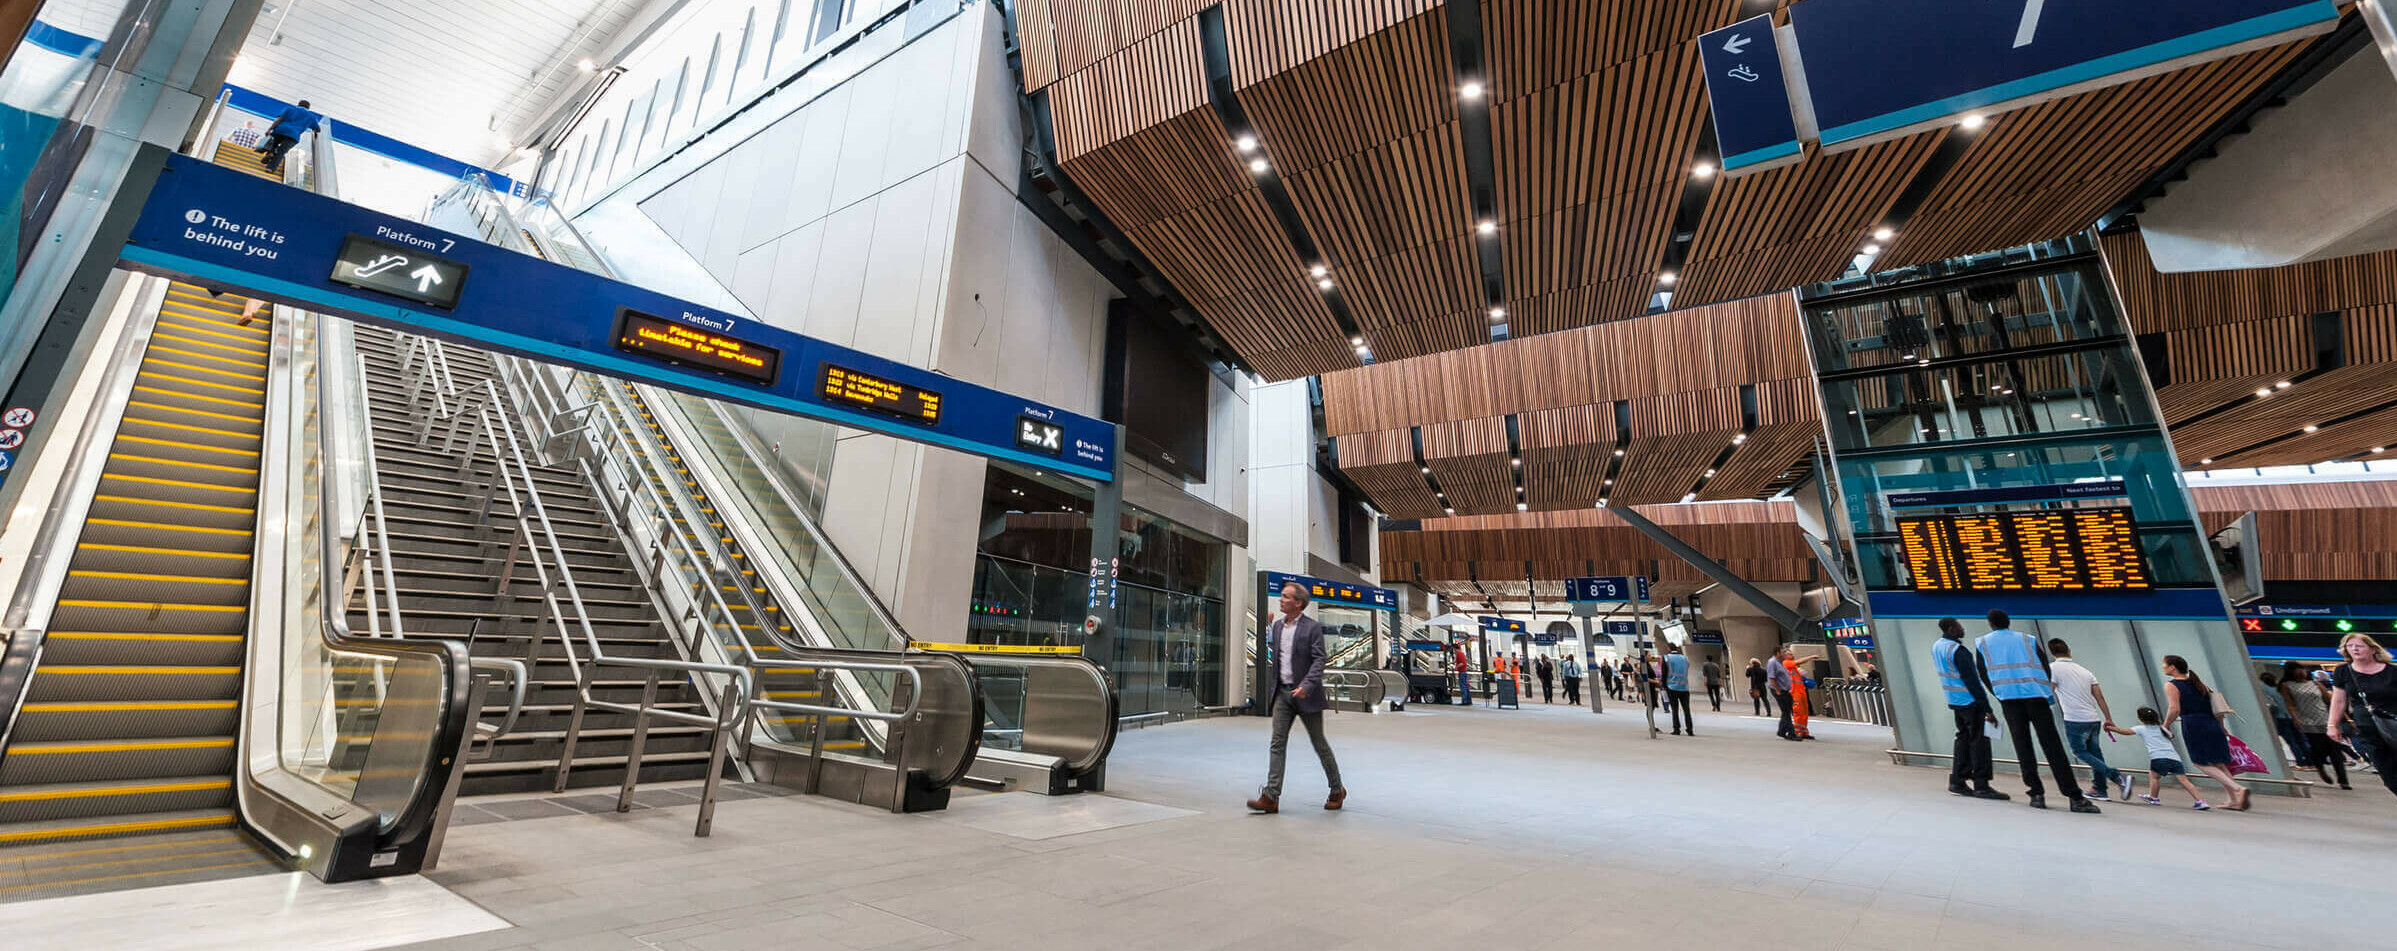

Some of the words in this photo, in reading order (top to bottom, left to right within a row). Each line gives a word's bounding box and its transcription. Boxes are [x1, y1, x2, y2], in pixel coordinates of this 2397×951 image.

[211, 215, 241, 233] The
[243, 224, 269, 240] lift
[271, 231, 286, 244] is
[183, 227, 246, 251] behind
[245, 245, 278, 260] you
[376, 226, 436, 250] Platform
[440, 238, 456, 254] 7
[682, 311, 723, 330] Platform
[725, 319, 736, 332] 7
[669, 325, 708, 343] Please
[709, 337, 742, 351] check
[638, 326, 693, 349] timetable
[695, 342, 715, 354] for
[717, 350, 764, 367] services
[1024, 406, 1048, 419] Platform
[1048, 409, 1054, 420] 7
[1022, 430, 1042, 445] Entry
[1083, 441, 1092, 450] The
[1077, 449, 1094, 460] behind
[1590, 584, 1599, 597] 8
[1607, 584, 1616, 597] 9
[2275, 607, 2331, 615] Underground
[918, 641, 932, 649] ENTRY
